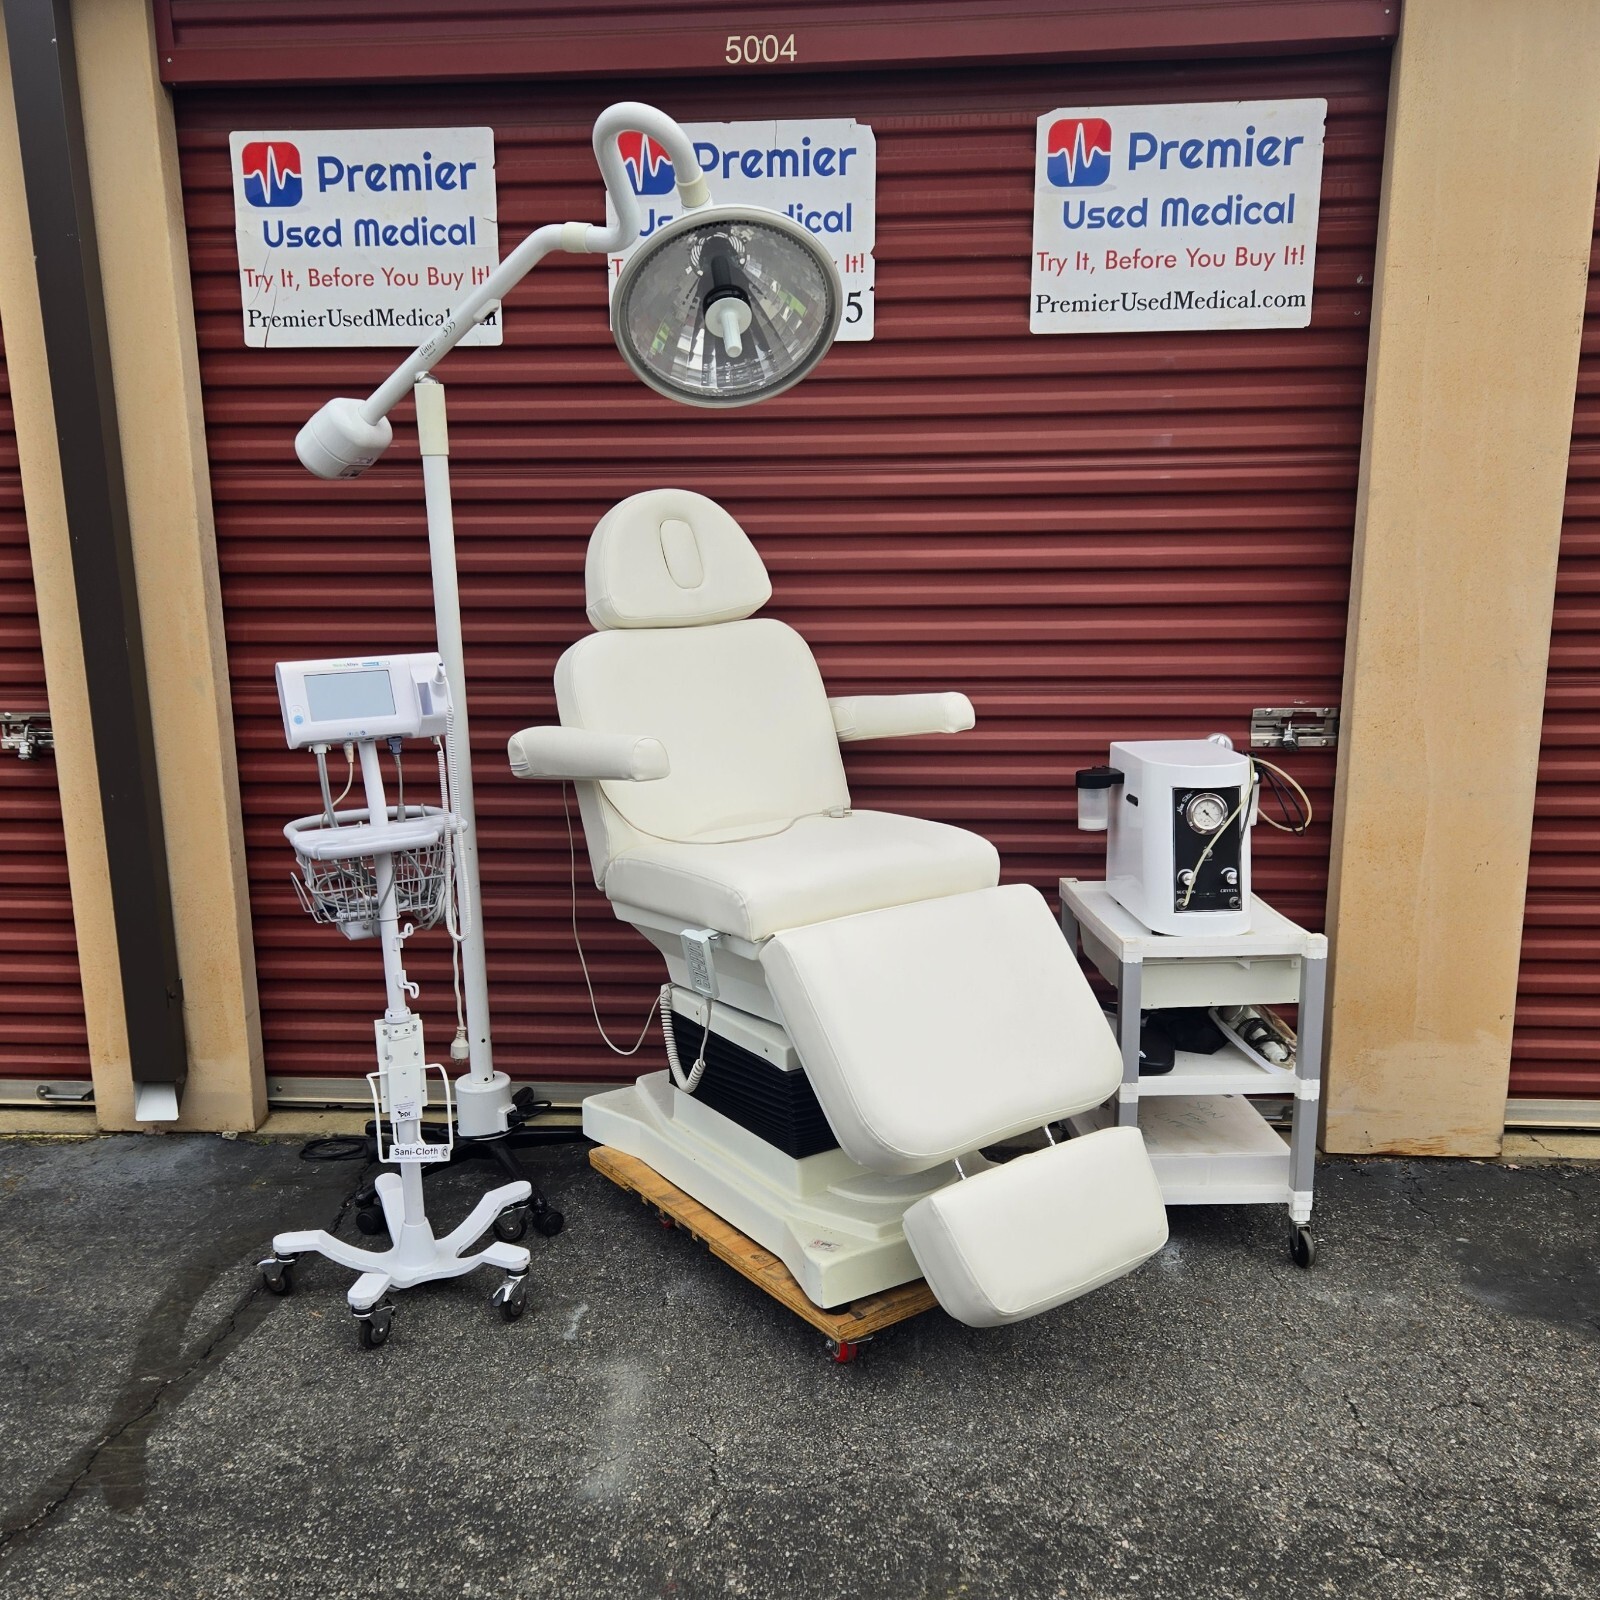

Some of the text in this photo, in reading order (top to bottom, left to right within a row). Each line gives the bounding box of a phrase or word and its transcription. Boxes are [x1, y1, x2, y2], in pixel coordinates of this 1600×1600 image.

[725, 33, 798, 64] 5004
[692, 136, 857, 180] Premier
[1128, 125, 1305, 171] Premier
[317, 151, 477, 193] Premier
[1063, 193, 1296, 229] Used Medical
[263, 216, 476, 248] Used Medical
[845, 253, 864, 273] It!
[1036, 244, 1305, 277] Try It, Before You Buy It!
[243, 268, 273, 293] Try
[281, 268, 300, 291] It,
[308, 267, 375, 288] Before
[381, 267, 419, 287] You
[427, 266, 464, 291] Buy
[1035, 289, 1306, 314] PremierUsedMedical.com
[394, 1147, 439, 1157] Sani-Cloth
